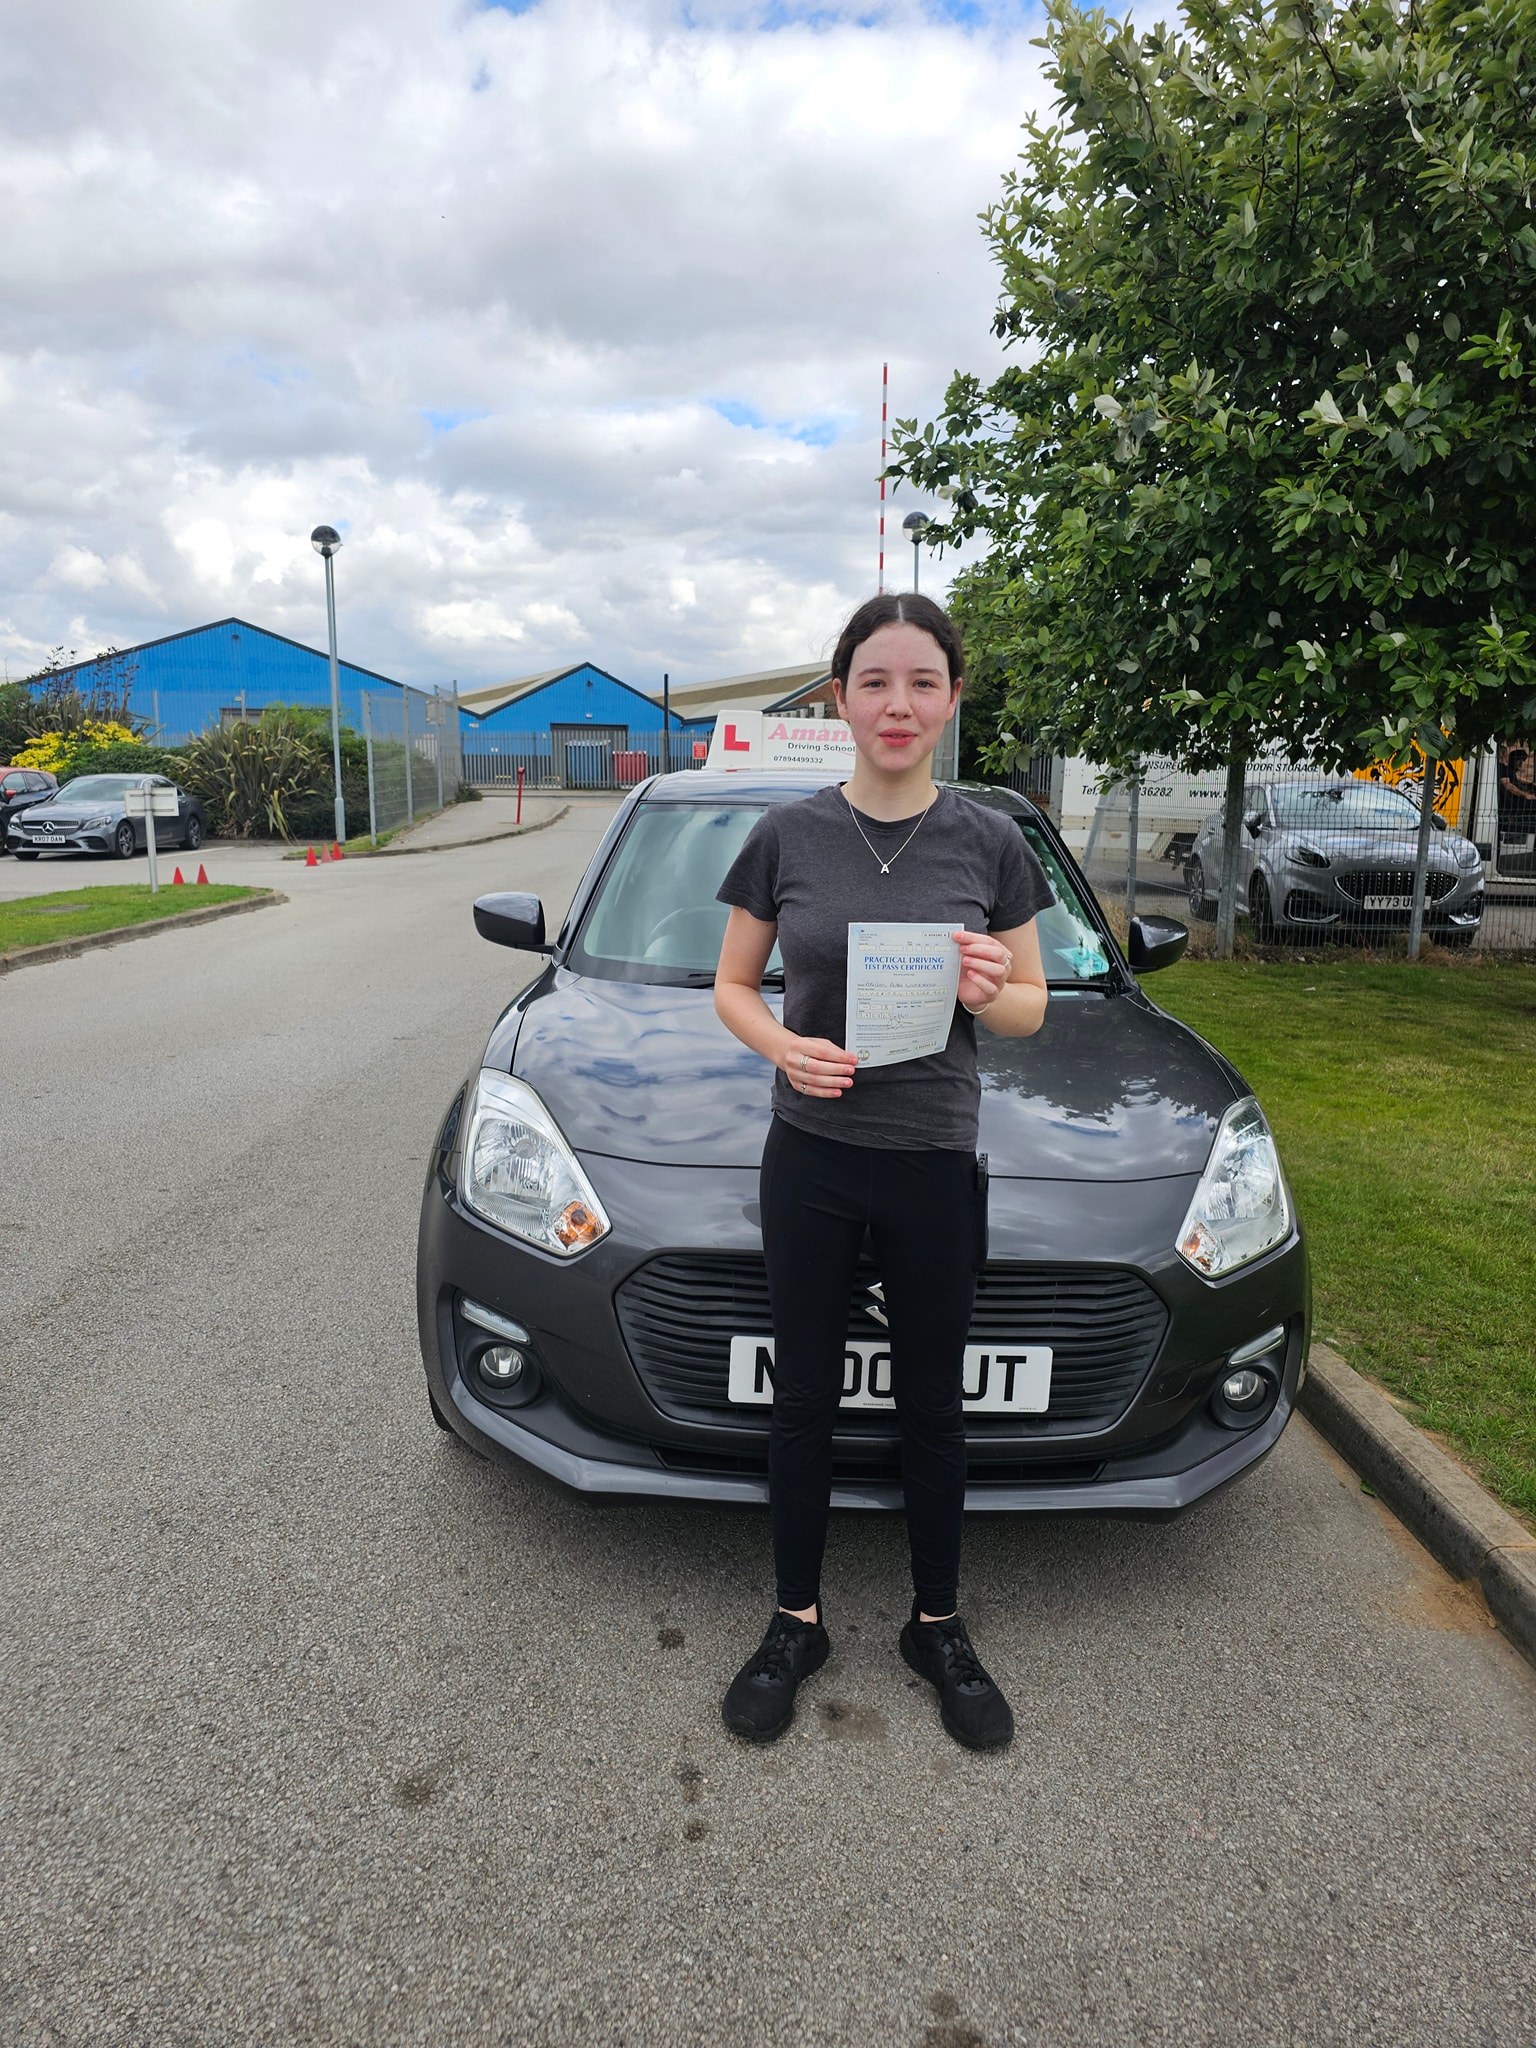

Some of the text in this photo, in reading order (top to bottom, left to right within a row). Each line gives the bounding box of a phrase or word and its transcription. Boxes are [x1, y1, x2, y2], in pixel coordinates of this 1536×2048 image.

[768, 722, 855, 743] Aman
[724, 725, 750, 751] L
[788, 742, 855, 753] Driving School
[1138, 787, 1173, 797] 36282
[1370, 897, 1400, 907] YY73
[864, 956, 945, 964] PRACTICAL DRIVING
